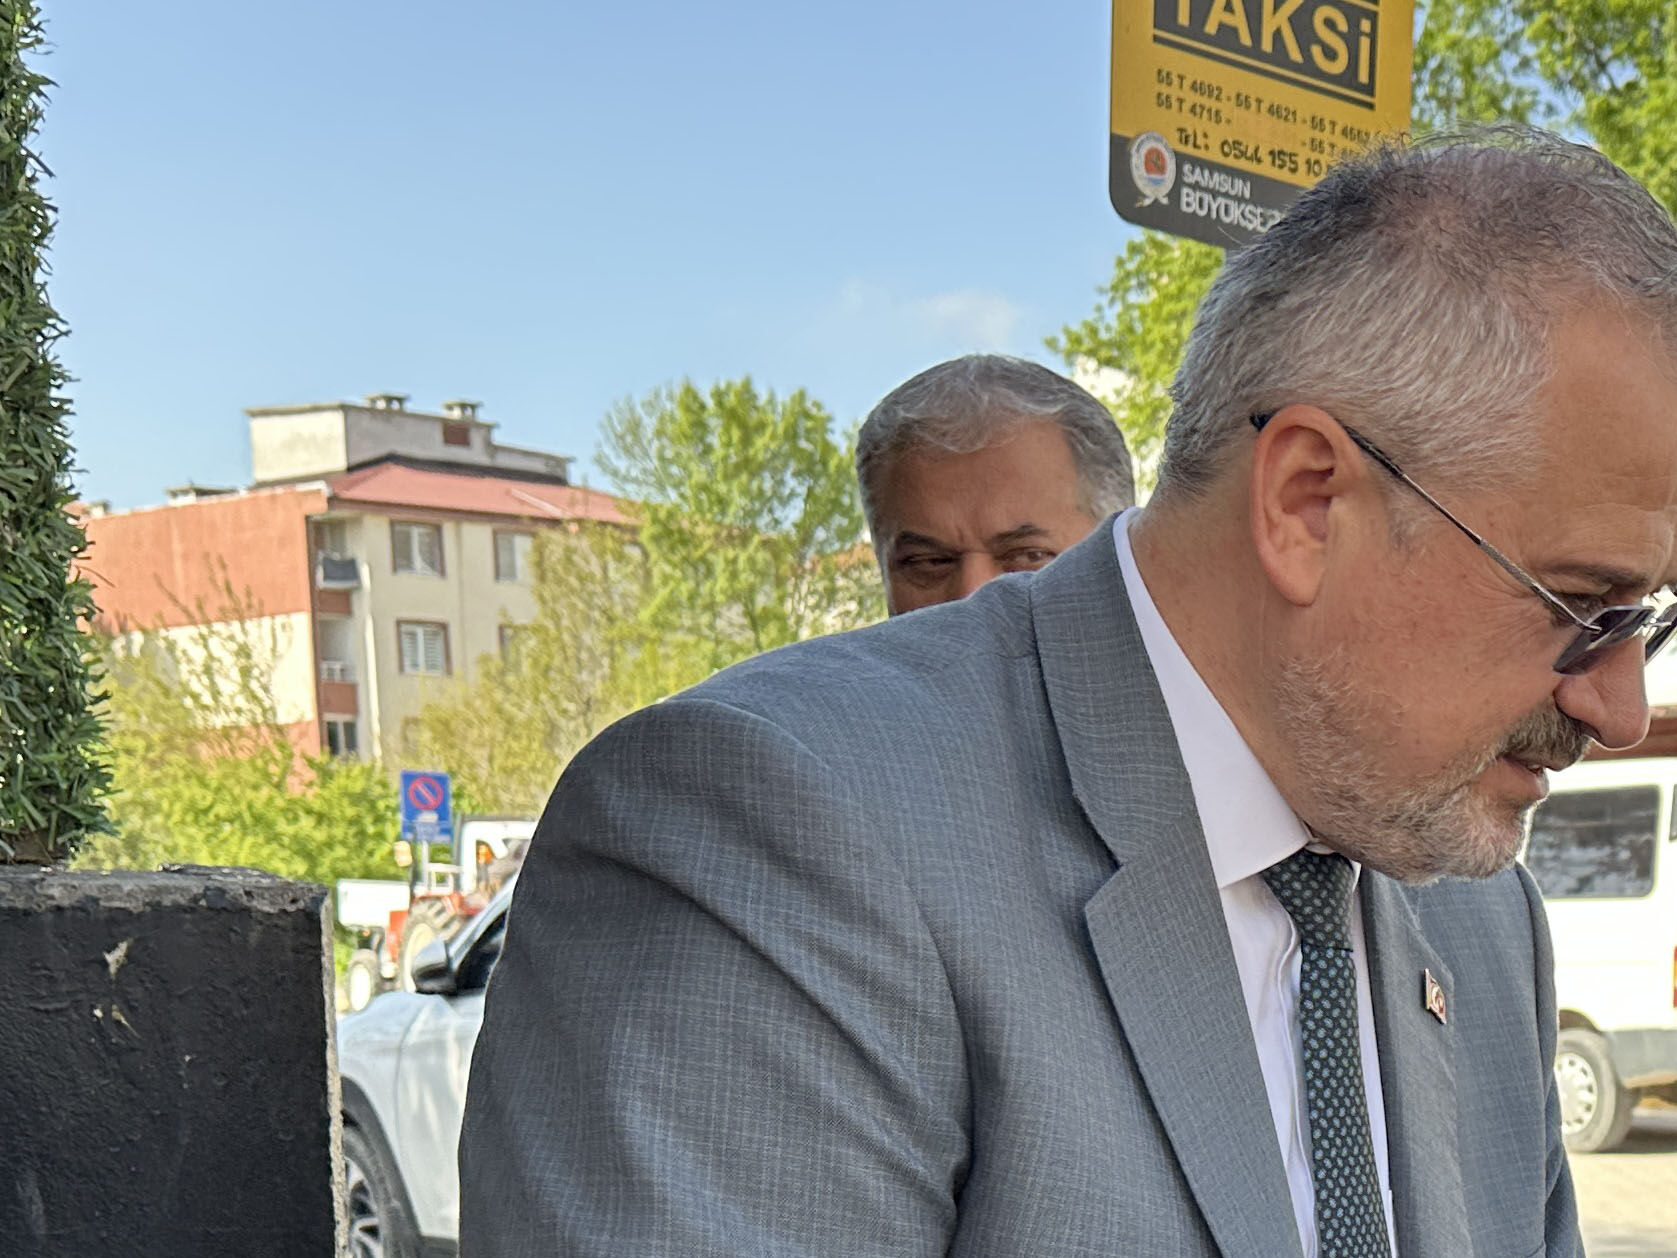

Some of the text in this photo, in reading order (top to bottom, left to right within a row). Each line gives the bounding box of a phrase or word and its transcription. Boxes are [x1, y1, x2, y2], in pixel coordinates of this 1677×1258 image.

[1176, 96, 1185, 113] T
[1177, 74, 1187, 91] T
[1255, 97, 1264, 114] T
[1329, 120, 1338, 136] T
[1268, 148, 1298, 174] 155
[1181, 162, 1251, 200] SAMSUN
